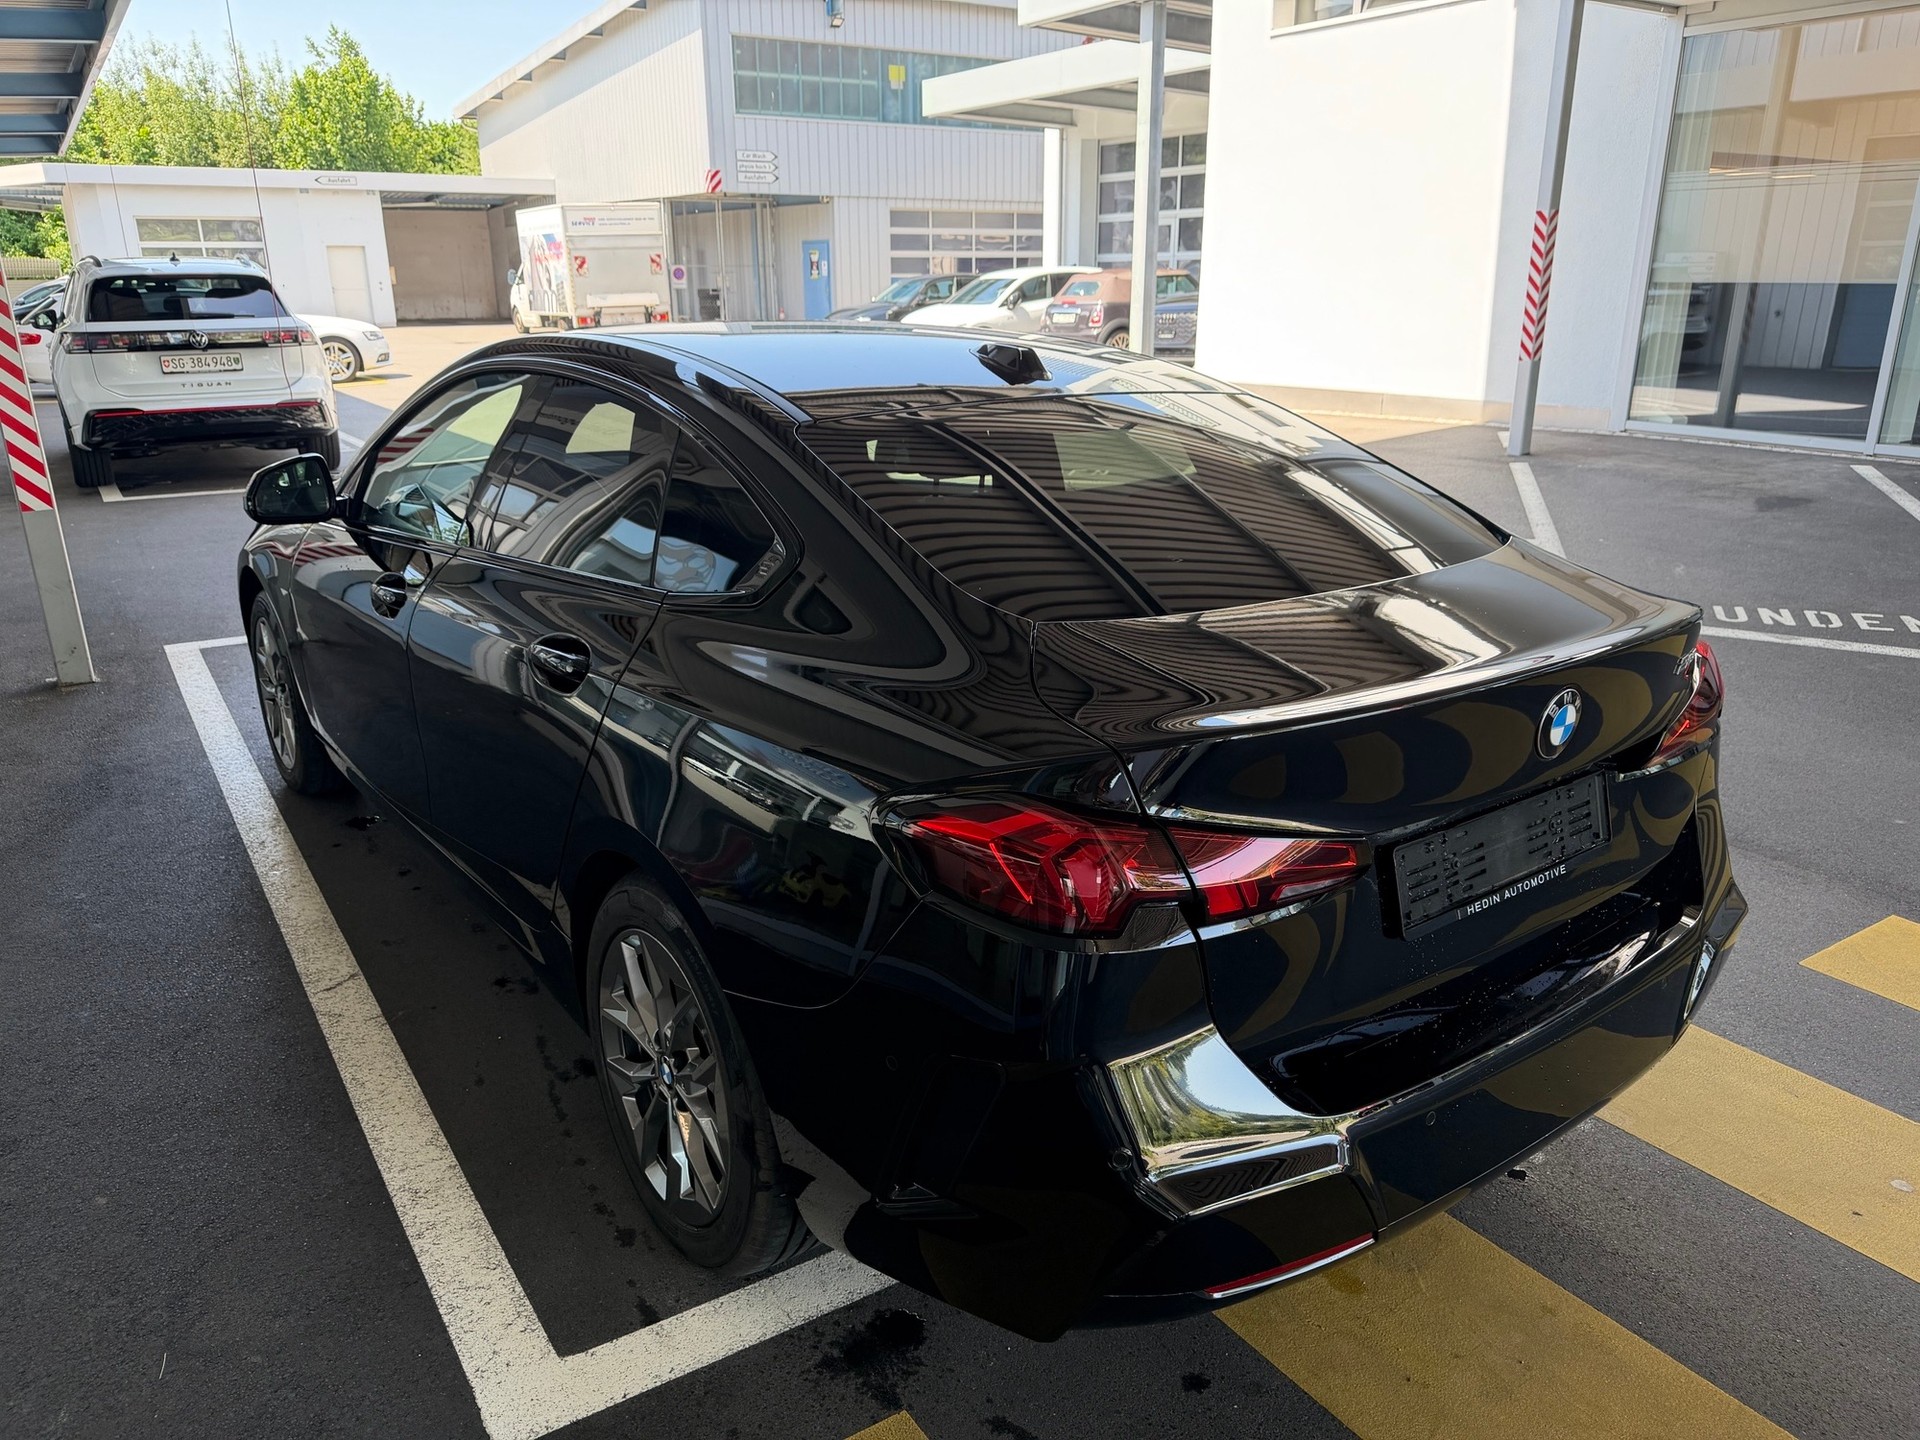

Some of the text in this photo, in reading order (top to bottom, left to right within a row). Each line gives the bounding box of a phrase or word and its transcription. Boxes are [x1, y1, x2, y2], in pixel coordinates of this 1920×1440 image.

[1548, 691, 1581, 718] BMW
[1466, 864, 1567, 915] HEDIN AUTOMOTIVE
